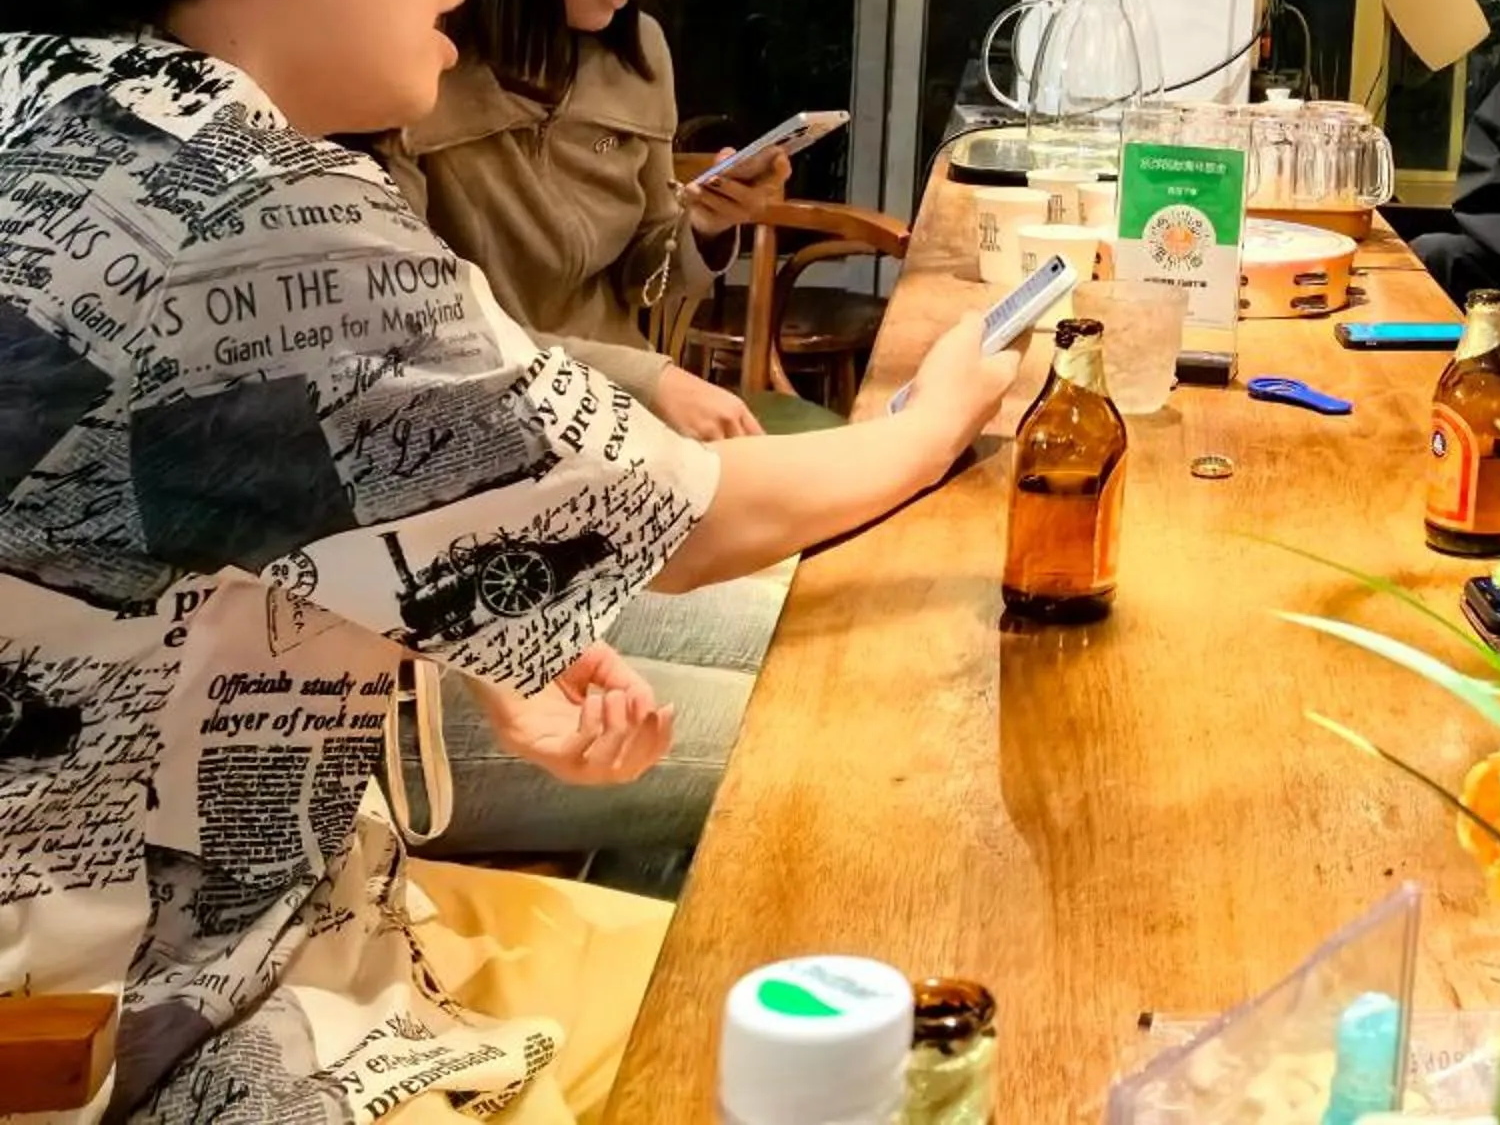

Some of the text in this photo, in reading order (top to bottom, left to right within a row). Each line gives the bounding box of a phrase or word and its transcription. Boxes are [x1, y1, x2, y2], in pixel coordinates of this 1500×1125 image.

[260, 204, 363, 231] Times
[205, 283, 258, 326] ON
[277, 268, 345, 313] THE
[367, 255, 460, 301] MOON
[280, 324, 334, 353] Leap
[340, 313, 371, 340] for
[207, 671, 293, 706] Officials
[300, 671, 355, 702] study
[272, 706, 302, 737] of
[304, 704, 347, 732] rock
